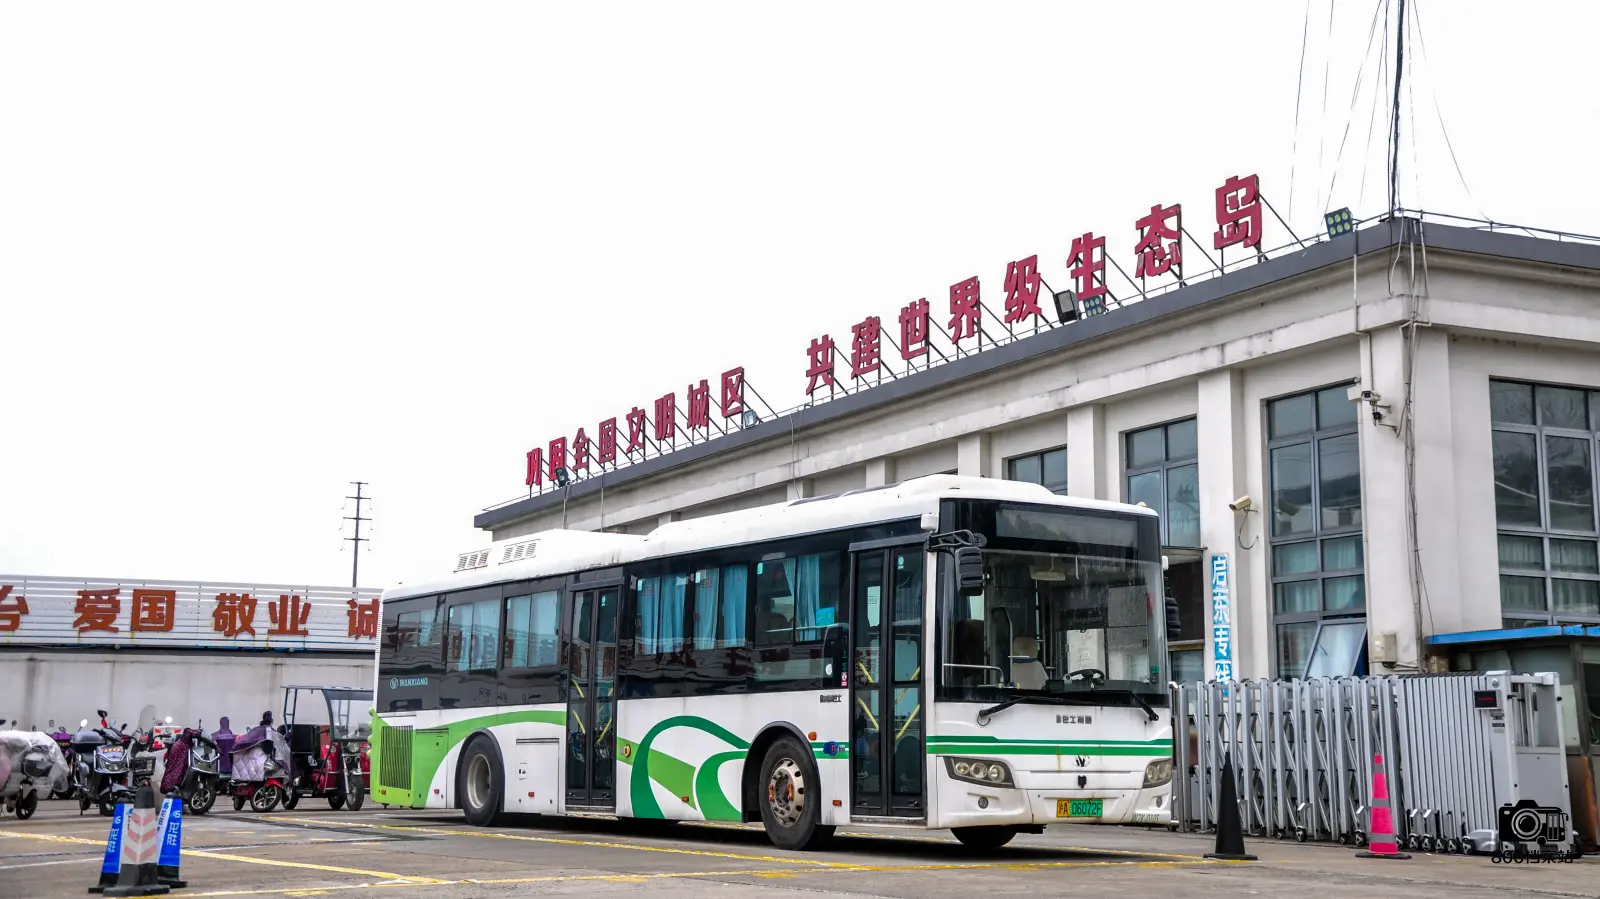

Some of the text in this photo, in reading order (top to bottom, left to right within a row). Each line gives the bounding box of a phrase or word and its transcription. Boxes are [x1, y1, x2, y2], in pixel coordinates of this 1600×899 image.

[526, 174, 1262, 486] 巩固全国文明城区 共建世界级生态岛
[73, 588, 176, 634] 爱国
[213, 593, 312, 638] 敬业
